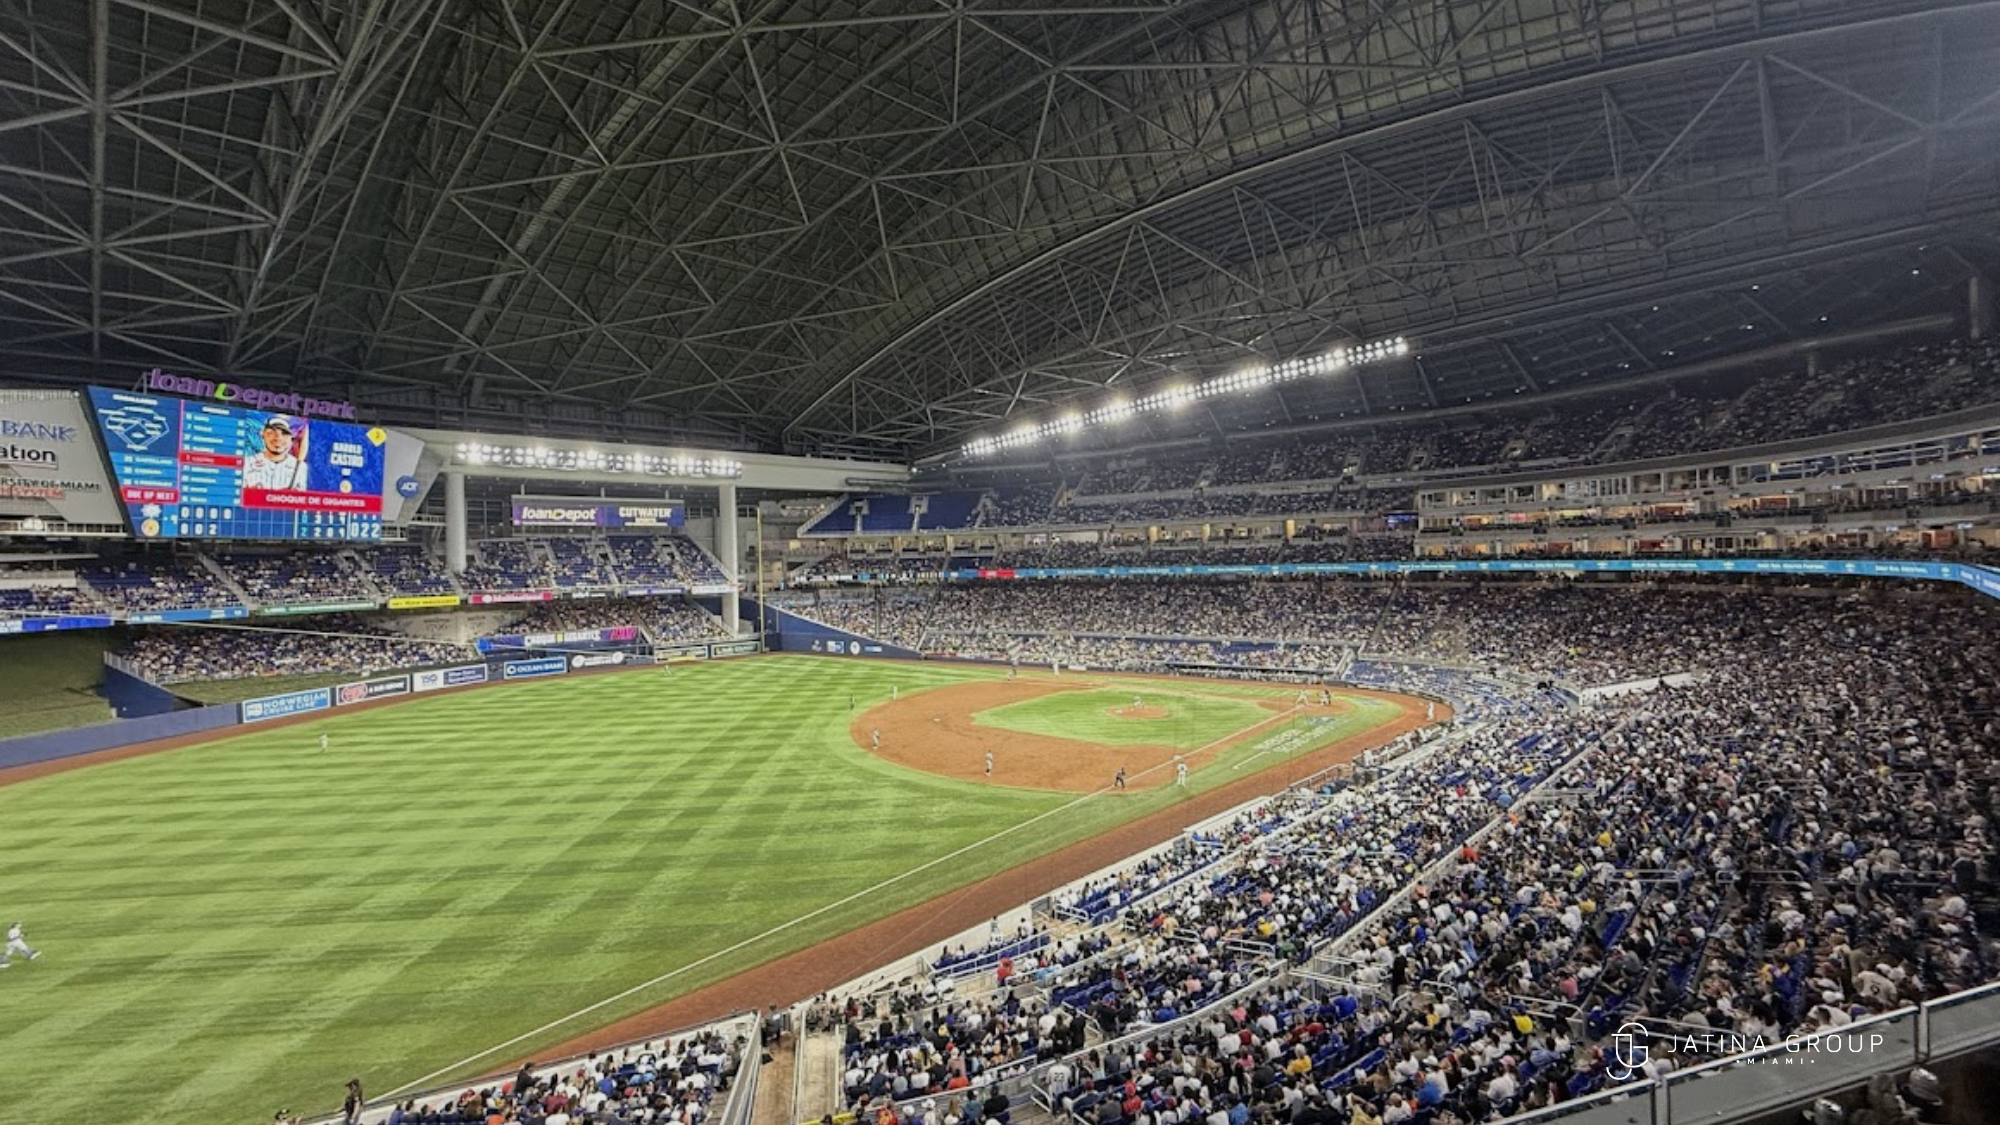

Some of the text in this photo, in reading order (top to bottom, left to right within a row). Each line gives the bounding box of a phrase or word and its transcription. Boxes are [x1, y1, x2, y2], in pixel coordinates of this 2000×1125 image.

[150, 368, 357, 419] loanDepot park
[1, 420, 77, 443] BANK
[60, 481, 100, 491] MIAMI
[266, 494, 366, 507] CHOQUE DE GIGANTES
[521, 506, 597, 521] loanDepot
[263, 692, 327, 708] NORWEGIAN
